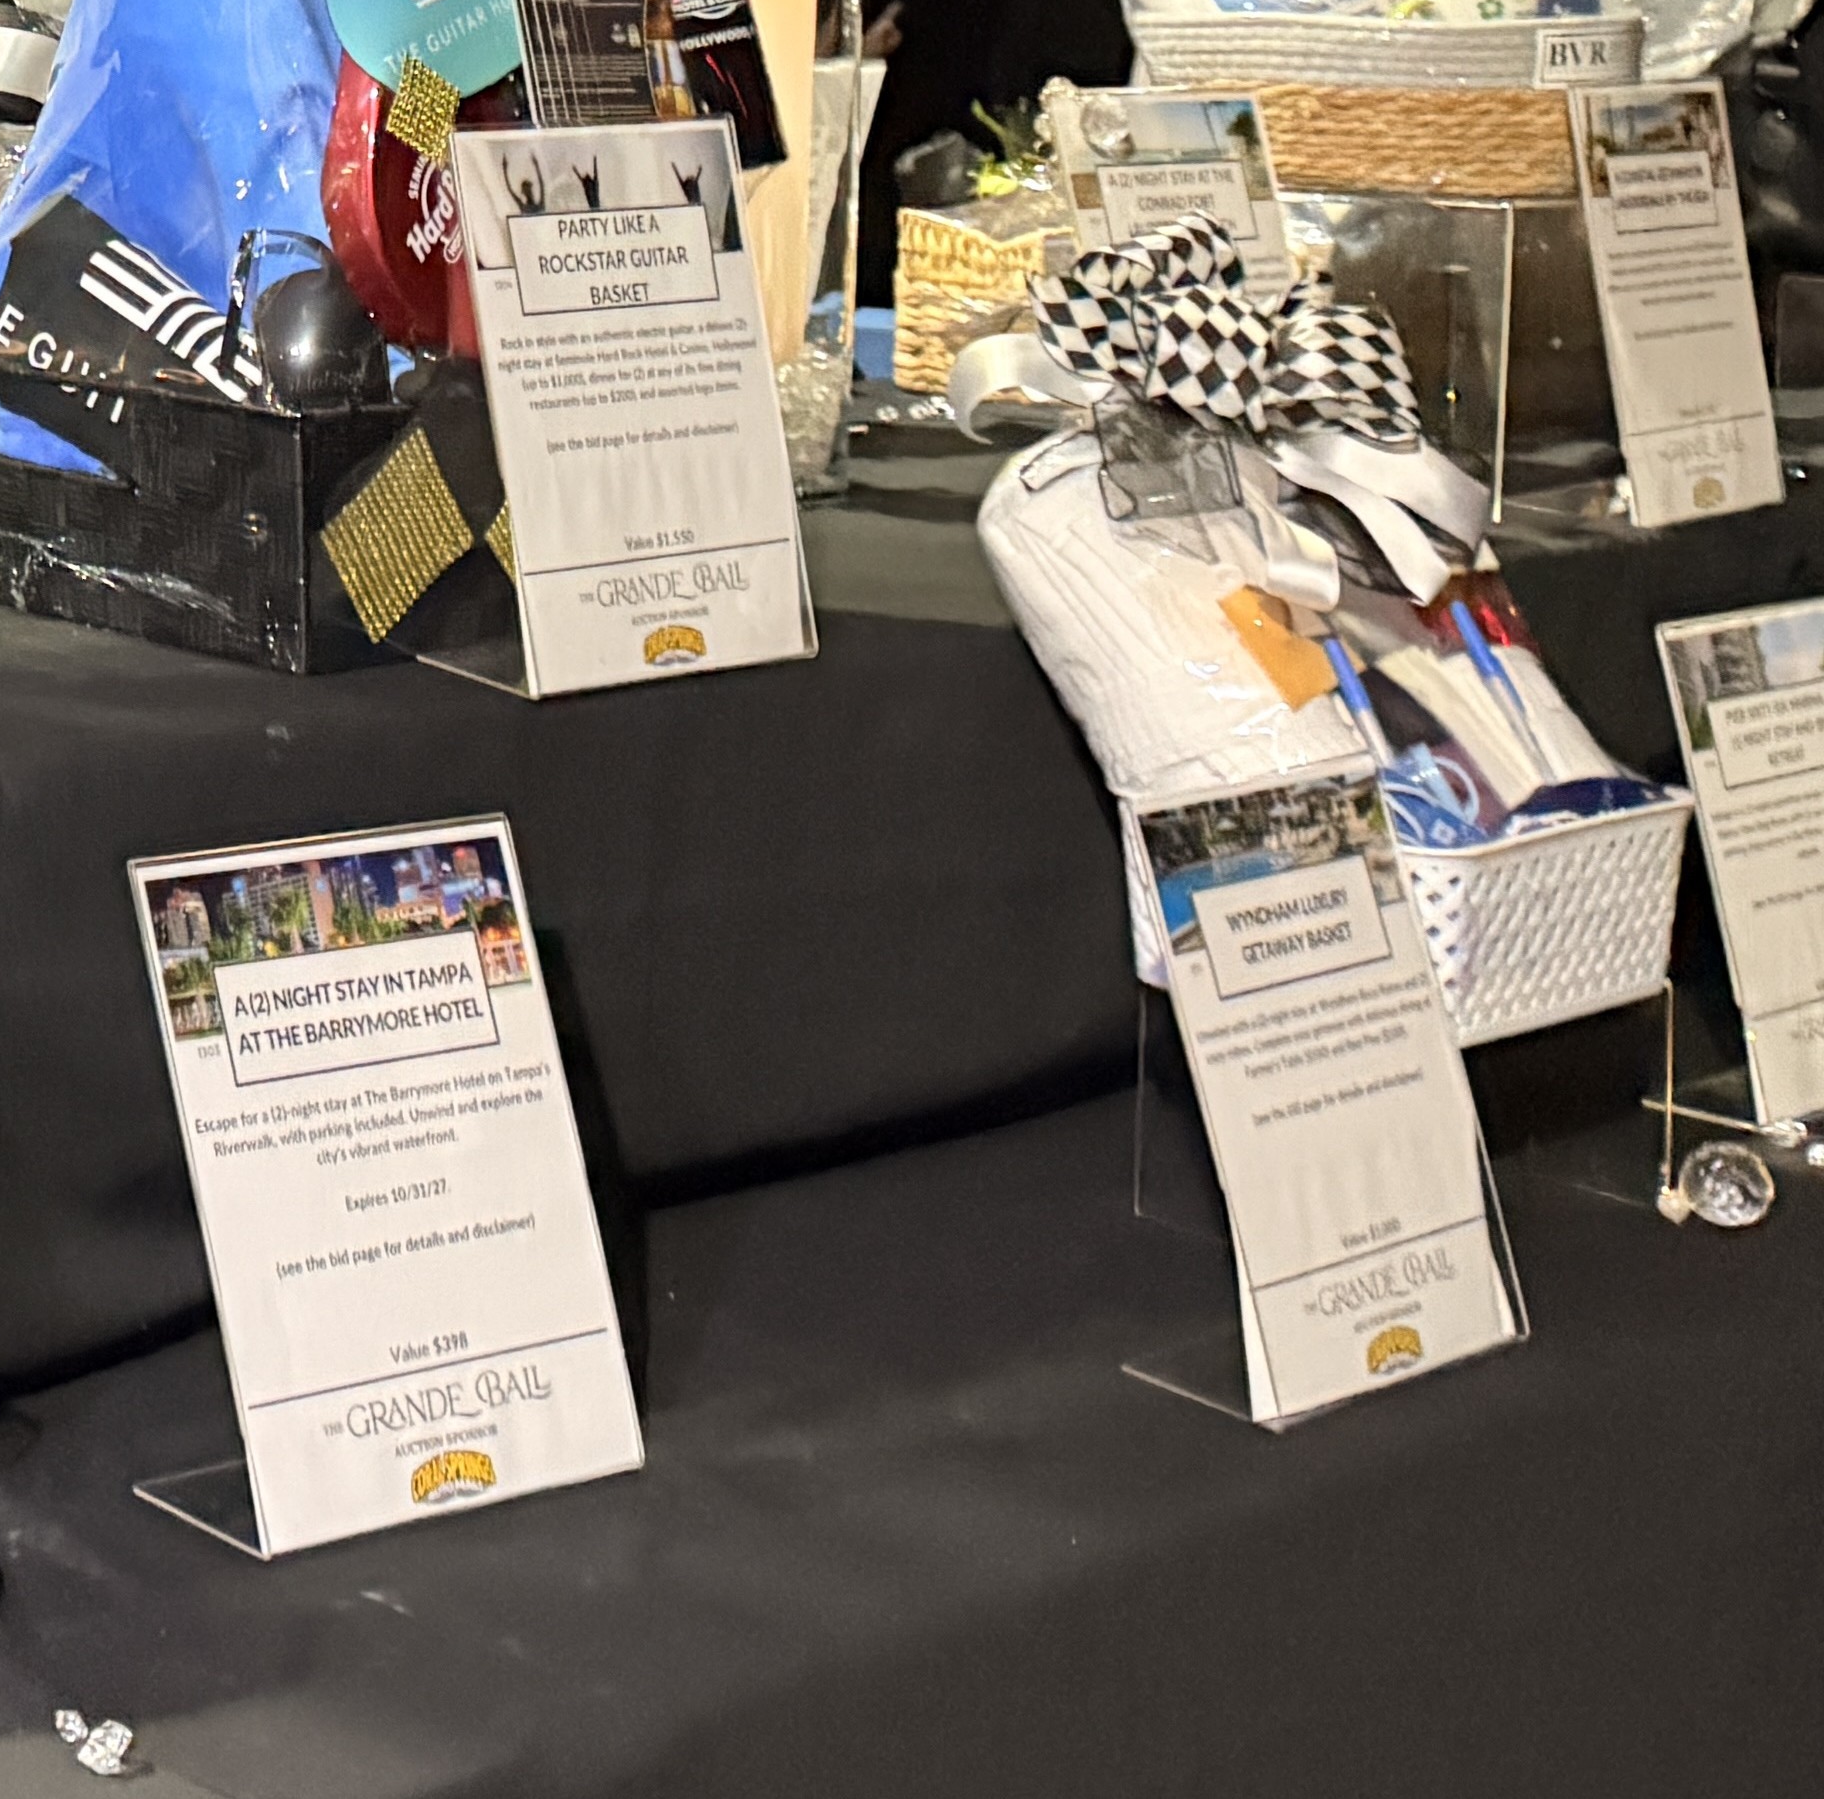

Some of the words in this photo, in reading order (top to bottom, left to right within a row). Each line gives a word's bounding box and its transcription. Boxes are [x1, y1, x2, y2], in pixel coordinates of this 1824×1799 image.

[1550, 41, 1608, 67] BVR
[557, 216, 609, 240] PARTY
[612, 213, 646, 235] LIKE
[648, 213, 660, 233] A
[537, 249, 627, 275] ROCKSTAR
[629, 245, 689, 268] GUITAR
[589, 281, 649, 306] BASKET
[234, 995, 249, 1018] A
[248, 990, 271, 1017] (2)
[271, 982, 331, 1011] NIGHT
[334, 974, 379, 1002] STAY
[382, 971, 404, 994] IN
[403, 961, 473, 990] TAMPA
[239, 1030, 261, 1055] AT
[262, 1024, 303, 1050] THE
[303, 1006, 422, 1044] BARRYMORE
[422, 997, 484, 1026] HOTEL
[346, 1382, 483, 1438] GRANDE
[474, 1364, 552, 1408] BALL
